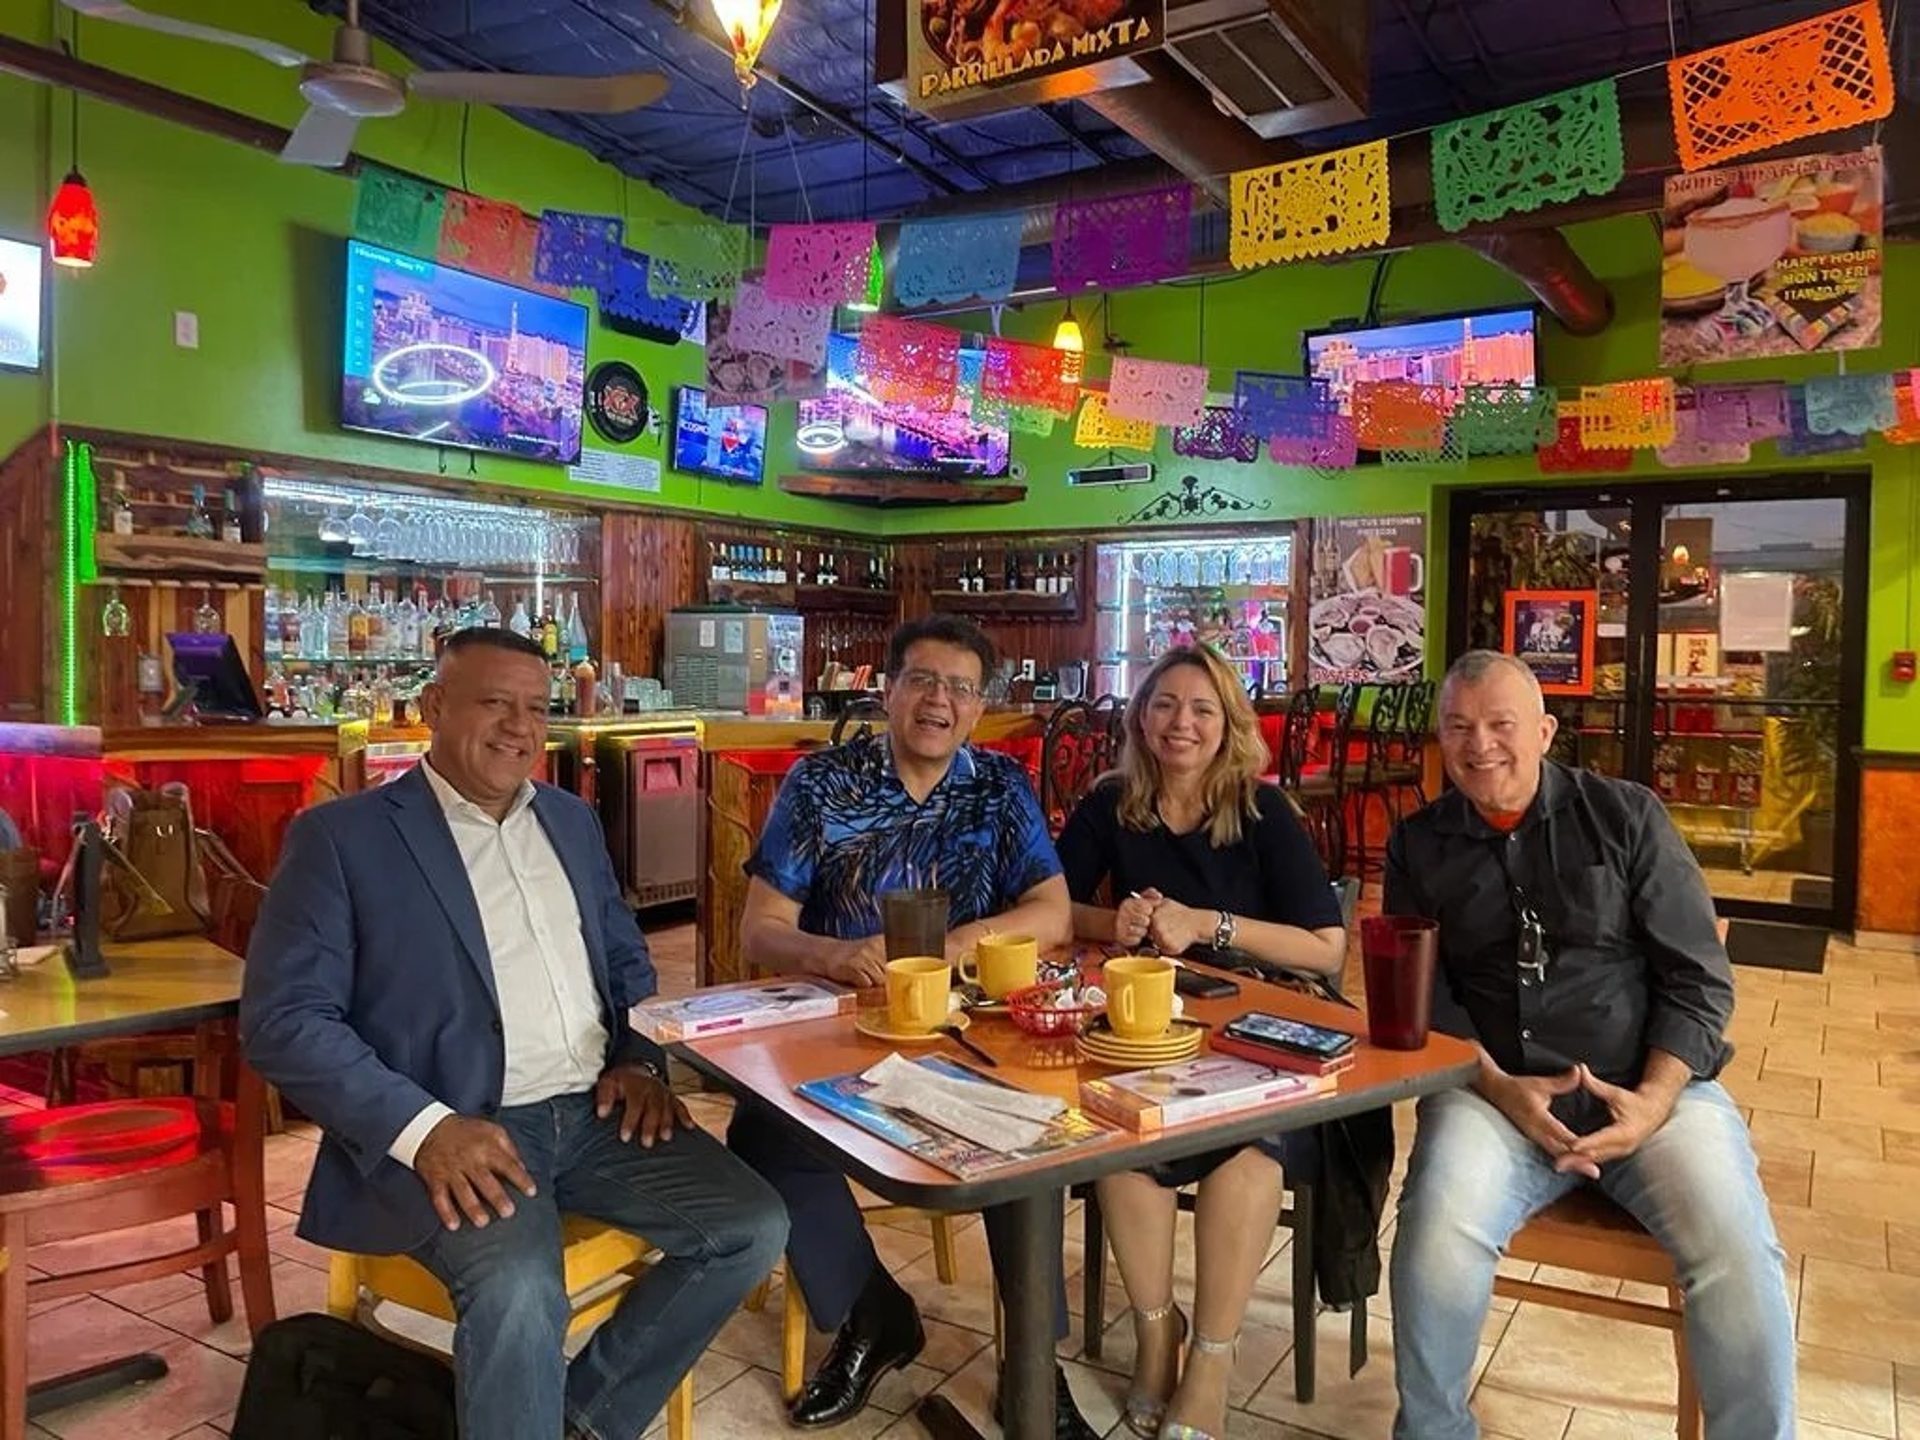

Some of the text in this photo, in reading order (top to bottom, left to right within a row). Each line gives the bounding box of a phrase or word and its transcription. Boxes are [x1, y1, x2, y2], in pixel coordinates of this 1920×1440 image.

[920, 17, 1151, 97] PARRILLADA MIXTA
[1775, 248, 1877, 269] HAPPY HOUR
[1821, 268, 1842, 280] TO
[1845, 265, 1869, 278] FRI
[1314, 669, 1368, 682] OYSTERS
